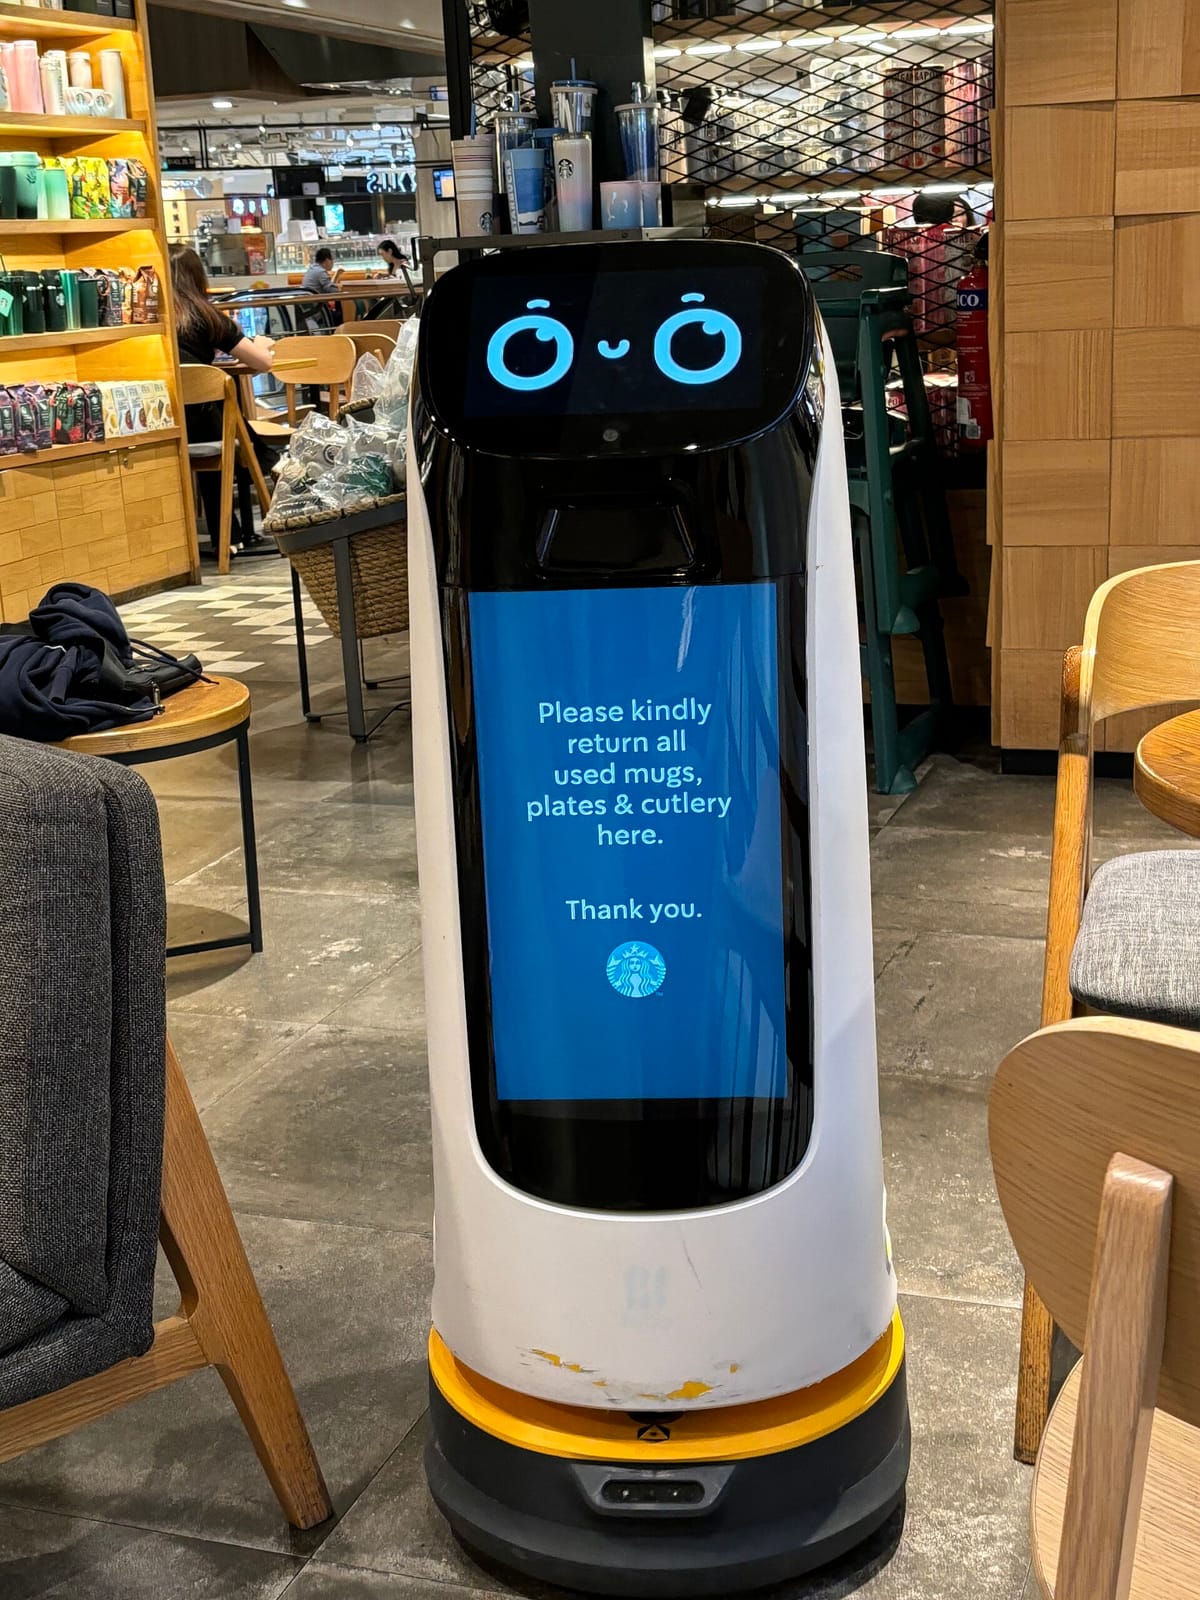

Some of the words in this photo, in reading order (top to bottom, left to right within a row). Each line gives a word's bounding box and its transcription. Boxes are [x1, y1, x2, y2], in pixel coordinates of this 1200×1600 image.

[539, 700, 623, 723] Please
[631, 697, 711, 724] kindly
[568, 733, 647, 753] return
[656, 729, 685, 751] all
[554, 762, 615, 785] used
[624, 766, 701, 787] mugs,
[527, 794, 606, 821] plates
[614, 794, 633, 814] &
[641, 791, 731, 817] cutlery
[597, 823, 662, 845] here.
[565, 898, 642, 919] Thank
[649, 903, 701, 923] you.
